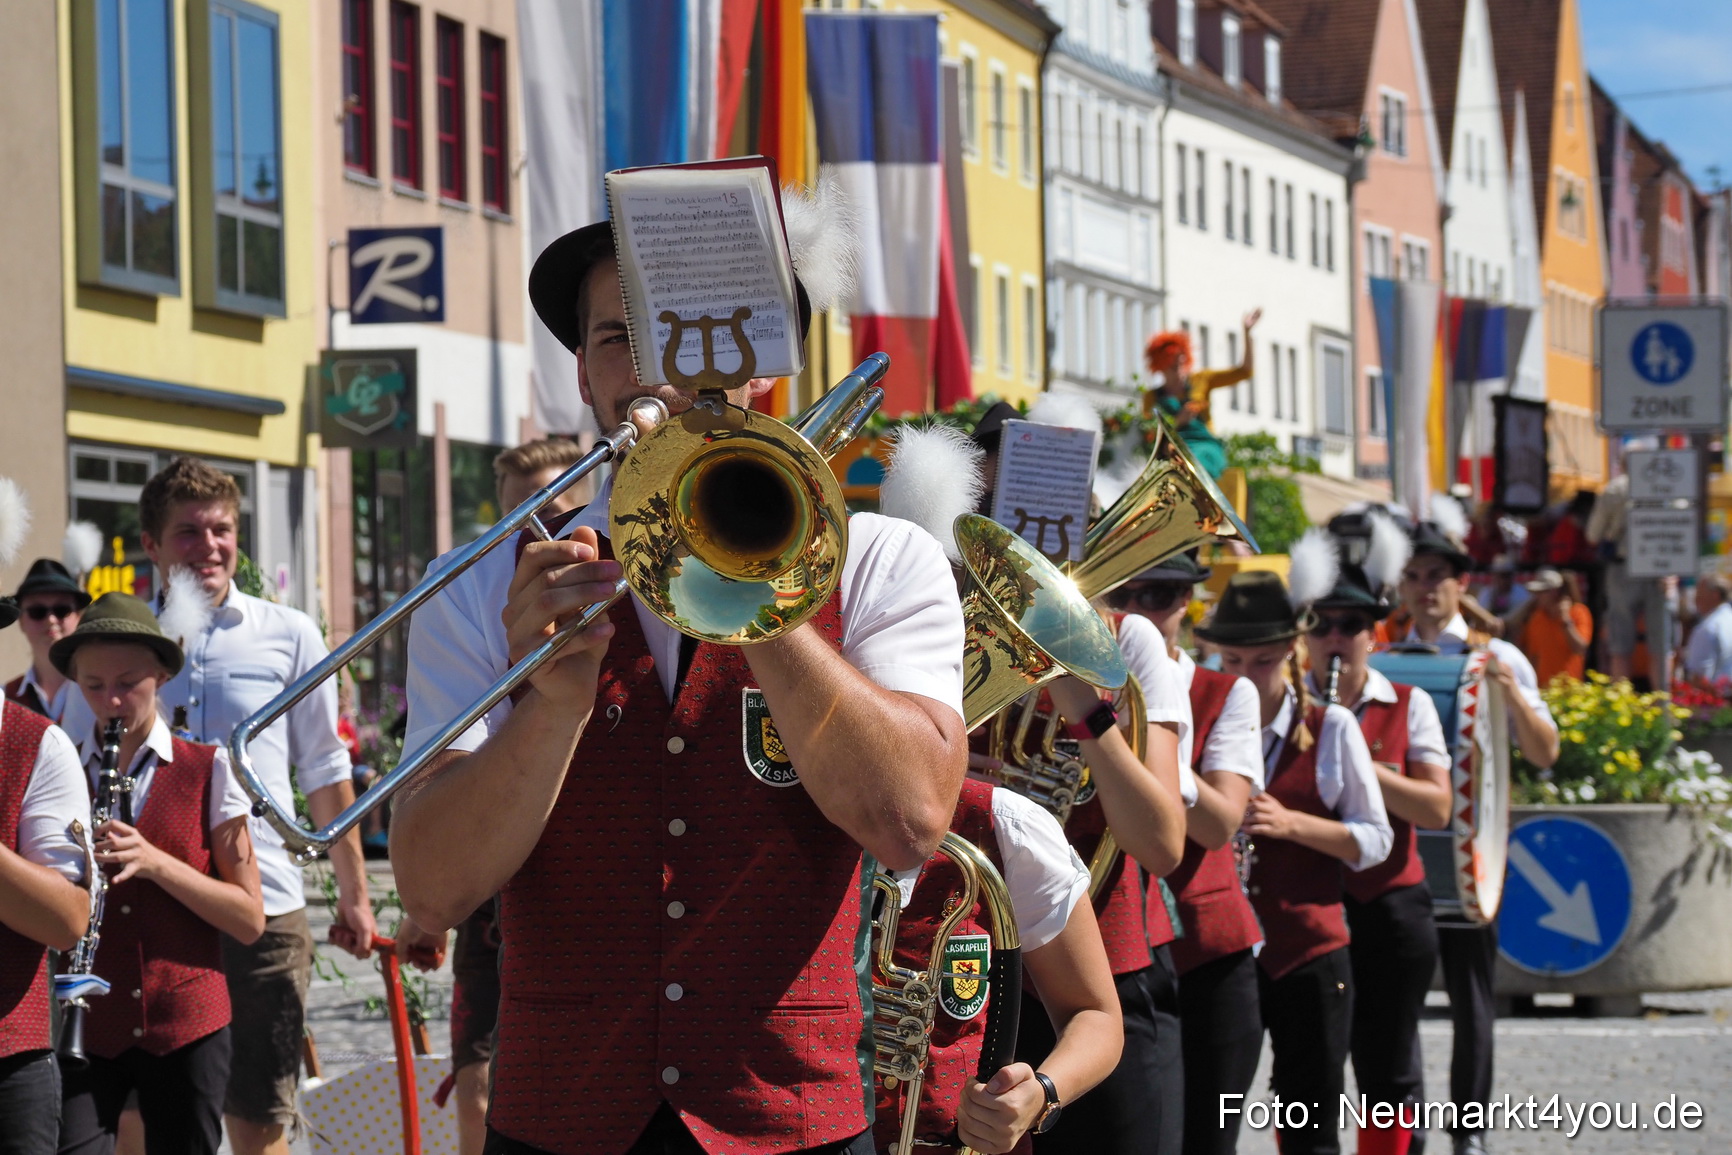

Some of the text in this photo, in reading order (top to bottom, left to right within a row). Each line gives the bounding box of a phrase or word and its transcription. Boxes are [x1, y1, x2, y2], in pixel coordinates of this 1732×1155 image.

[1631, 396, 1695, 418] ZONE
[753, 759, 799, 782] PILSAC
[945, 942, 988, 953] LASKAPELLE
[944, 995, 983, 1016] PILSACH
